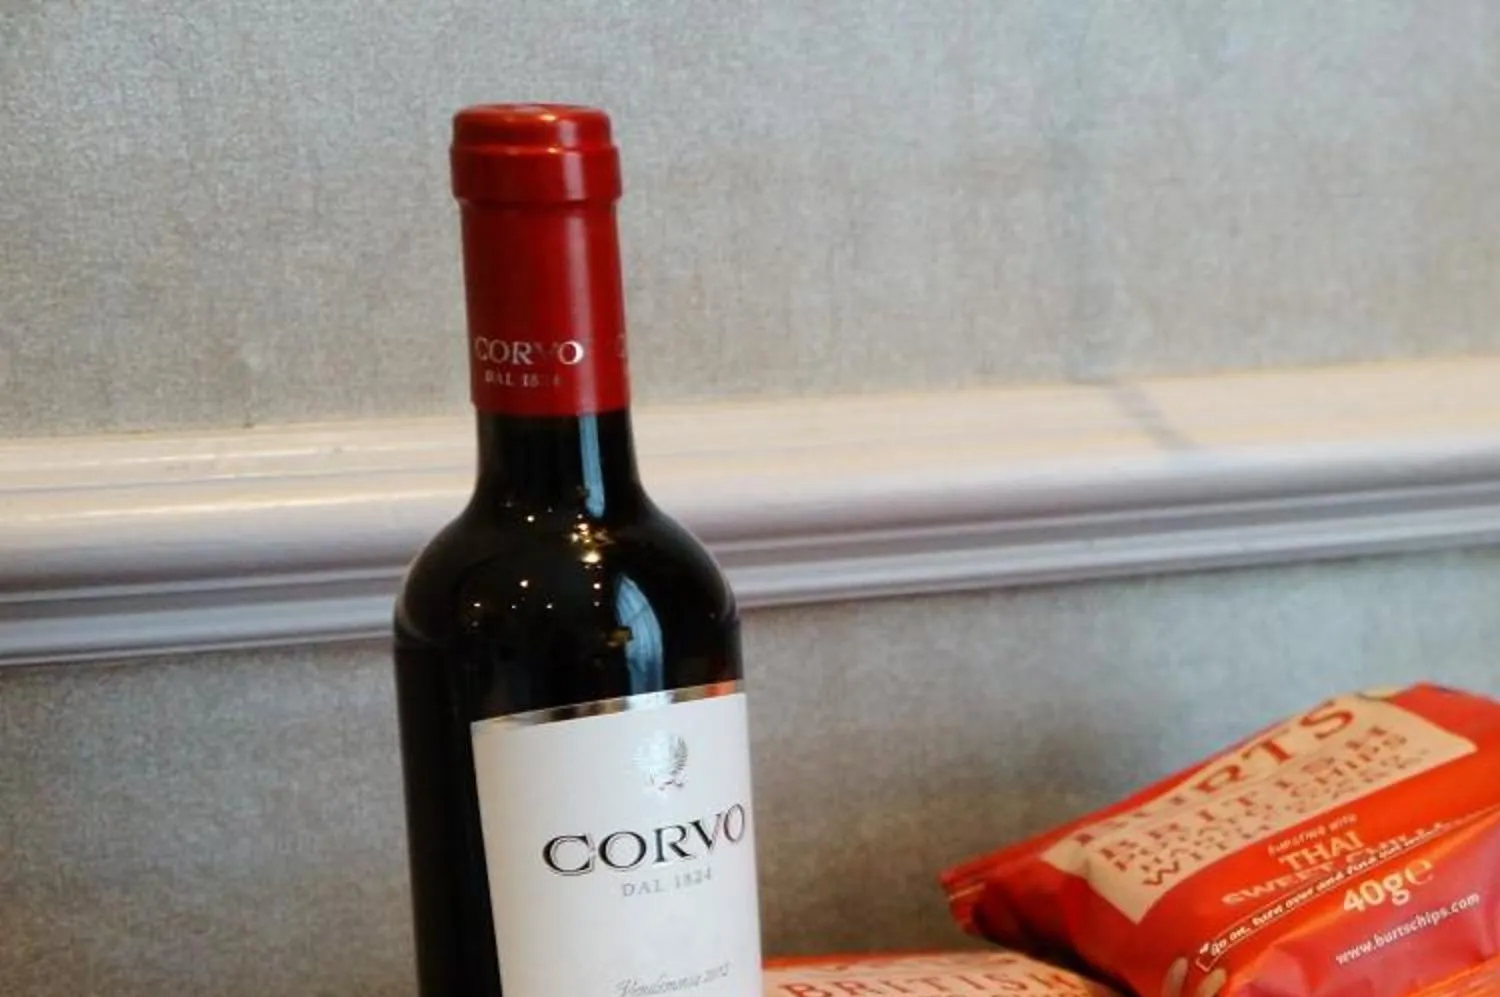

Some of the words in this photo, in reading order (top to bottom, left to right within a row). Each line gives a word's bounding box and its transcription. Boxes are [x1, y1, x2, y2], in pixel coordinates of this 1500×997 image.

[475, 336, 584, 365] CORO
[542, 803, 746, 876] CORVO
[1278, 830, 1364, 872] THAI
[622, 880, 664, 898] DAL
[675, 867, 712, 889] 1824
[1336, 892, 1480, 965] www.burtschips.com
